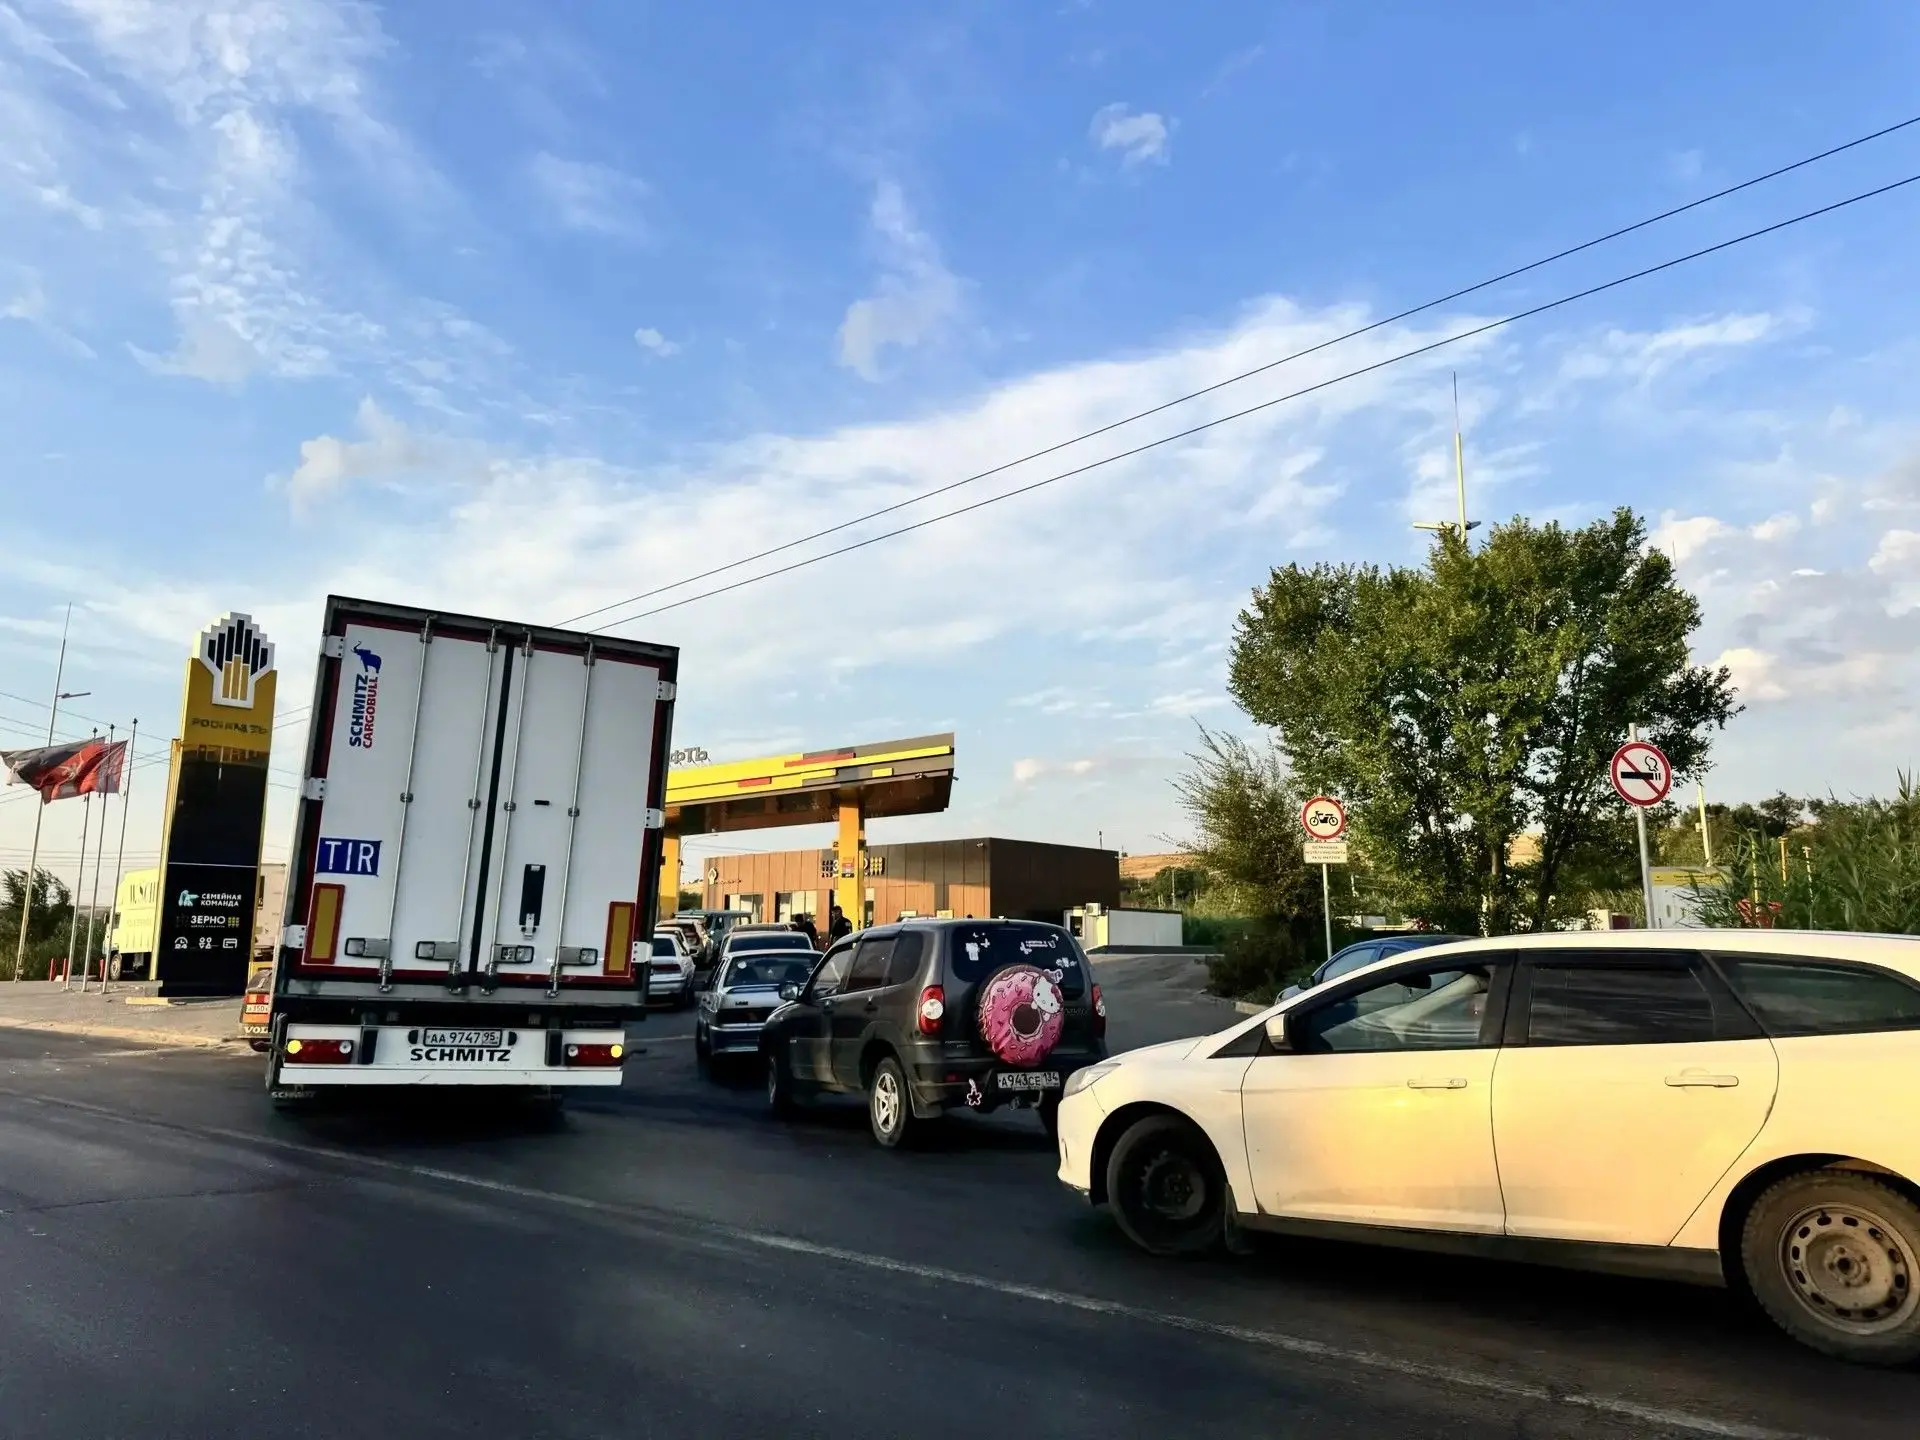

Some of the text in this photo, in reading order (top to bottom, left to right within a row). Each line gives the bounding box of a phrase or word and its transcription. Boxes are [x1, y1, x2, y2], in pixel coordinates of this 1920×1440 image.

[349, 673, 369, 747] SCHMITZ
[363, 676, 379, 749] CARGOBULL
[324, 840, 375, 873] TIR
[201, 893, 242, 901] СЕМЕЙНАЯ
[190, 915, 226, 925] ЗЕРНО
[243, 1026, 269, 1034] VOL
[449, 1032, 480, 1044] 9747
[410, 1048, 511, 1062] SCHMITZ
